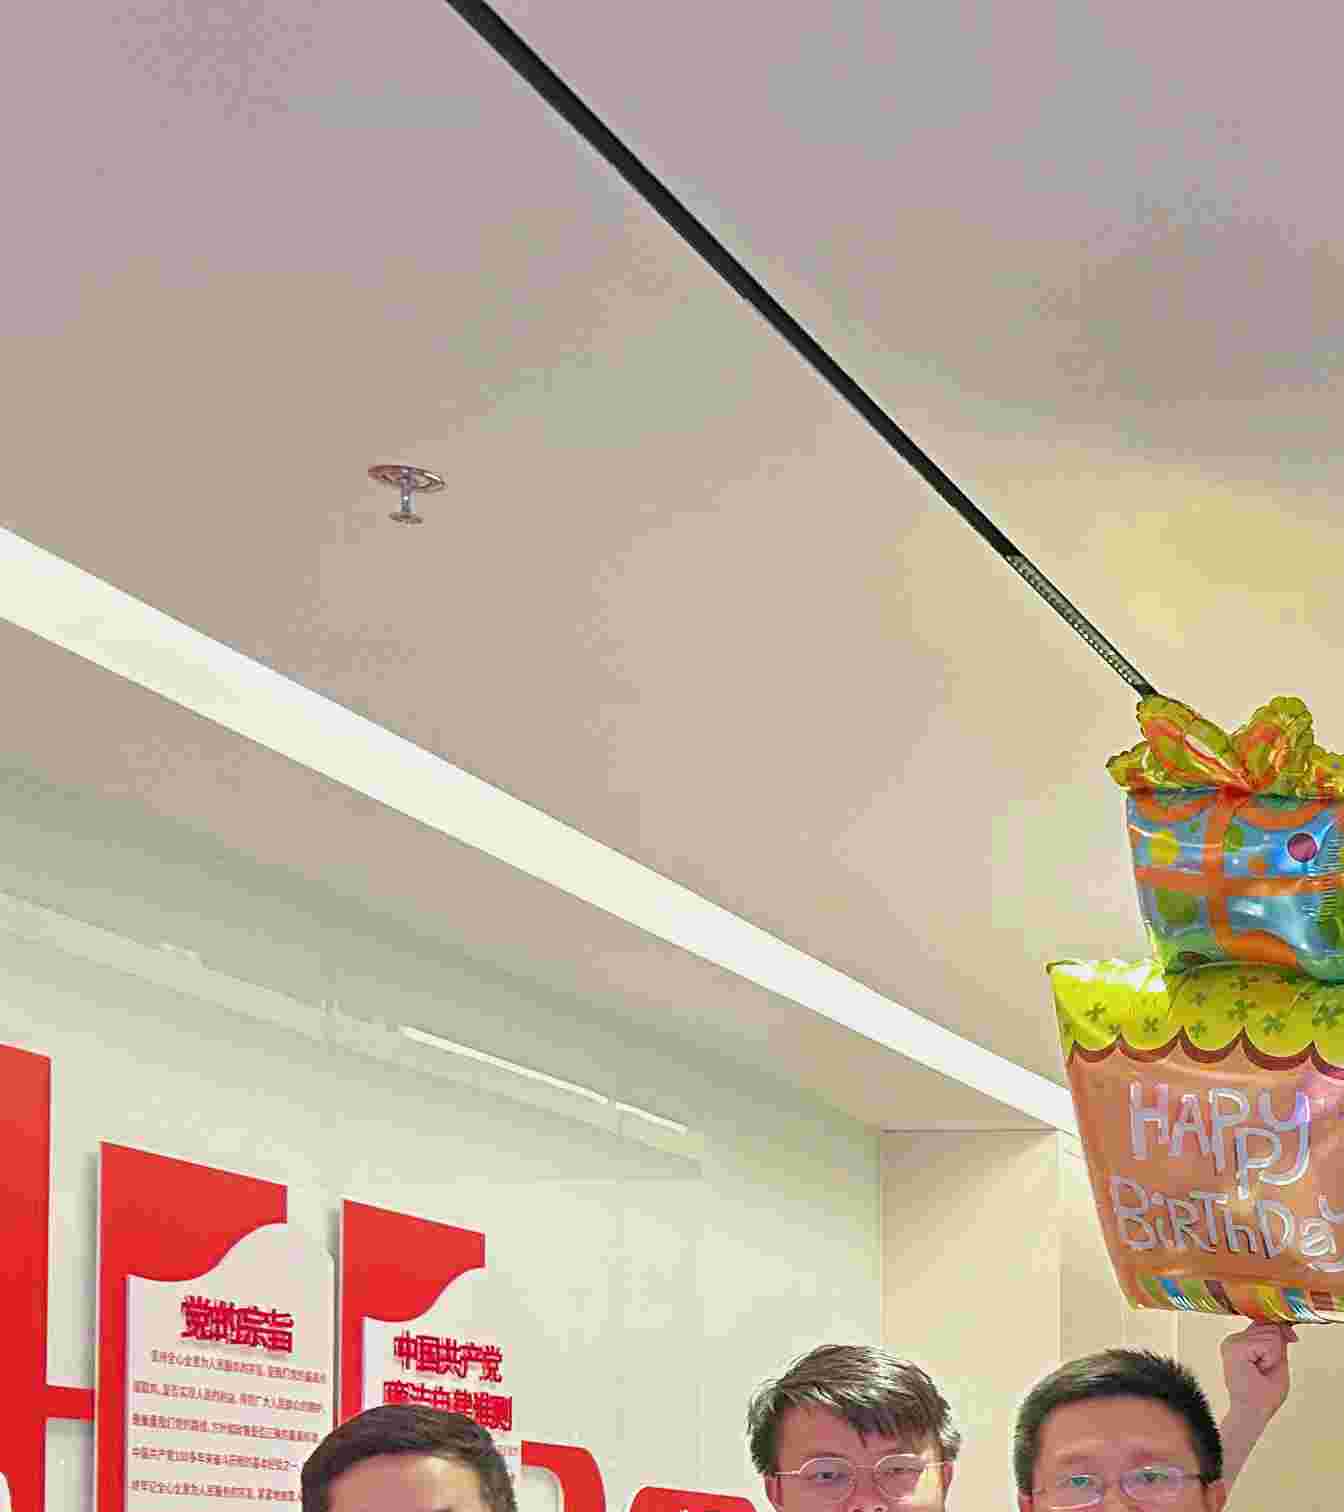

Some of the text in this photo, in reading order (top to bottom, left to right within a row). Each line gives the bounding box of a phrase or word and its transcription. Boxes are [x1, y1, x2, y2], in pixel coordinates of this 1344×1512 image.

[393, 1331, 503, 1383] 中国共产党
